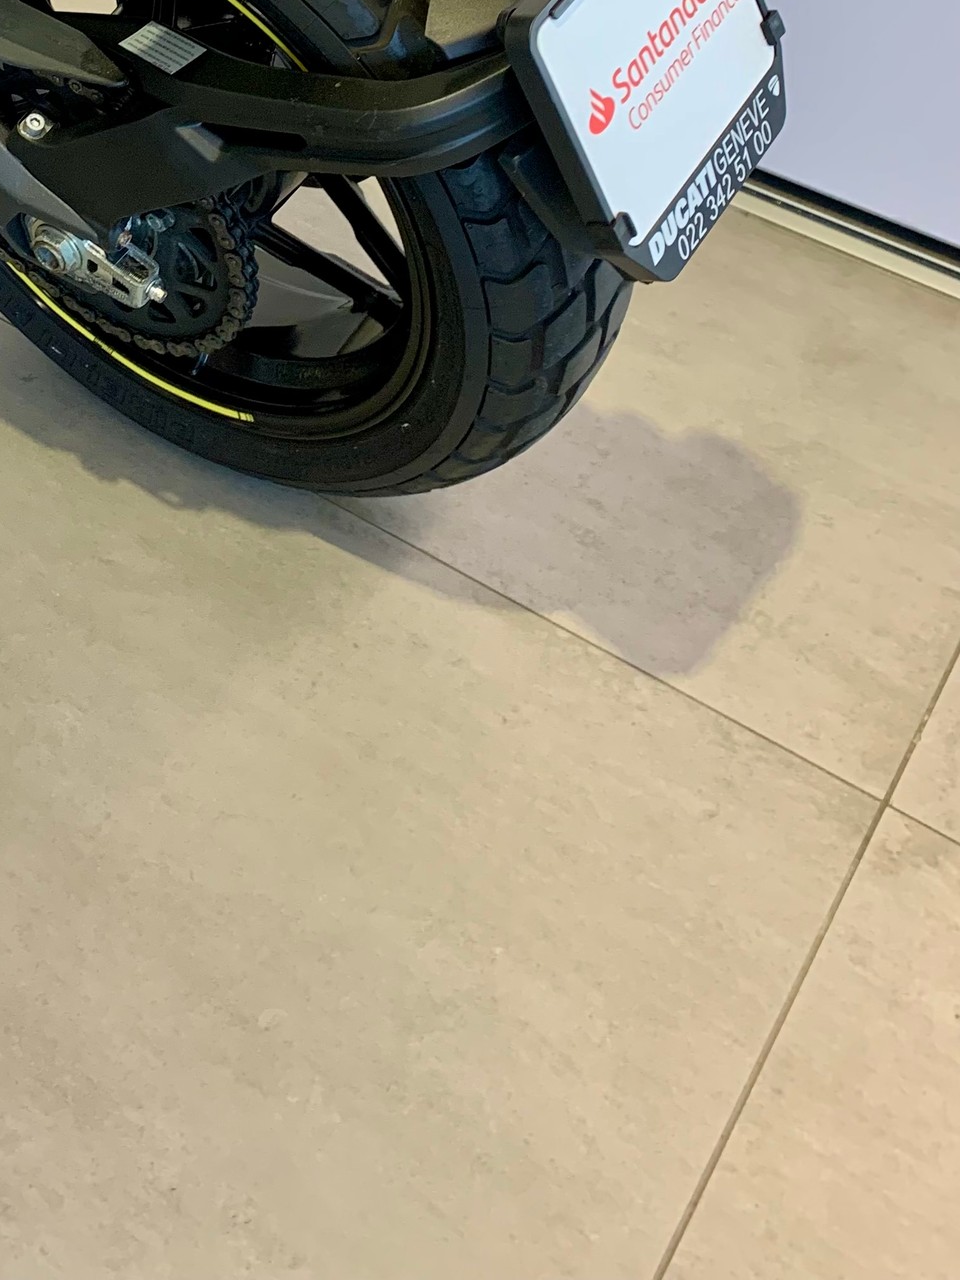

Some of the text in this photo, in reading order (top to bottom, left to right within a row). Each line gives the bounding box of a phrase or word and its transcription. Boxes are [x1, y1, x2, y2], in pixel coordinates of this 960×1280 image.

[628, 41, 694, 130] Consumer
[648, 88, 770, 266] DUCATI GENEVE
[678, 120, 773, 261] 022 342 51 00
